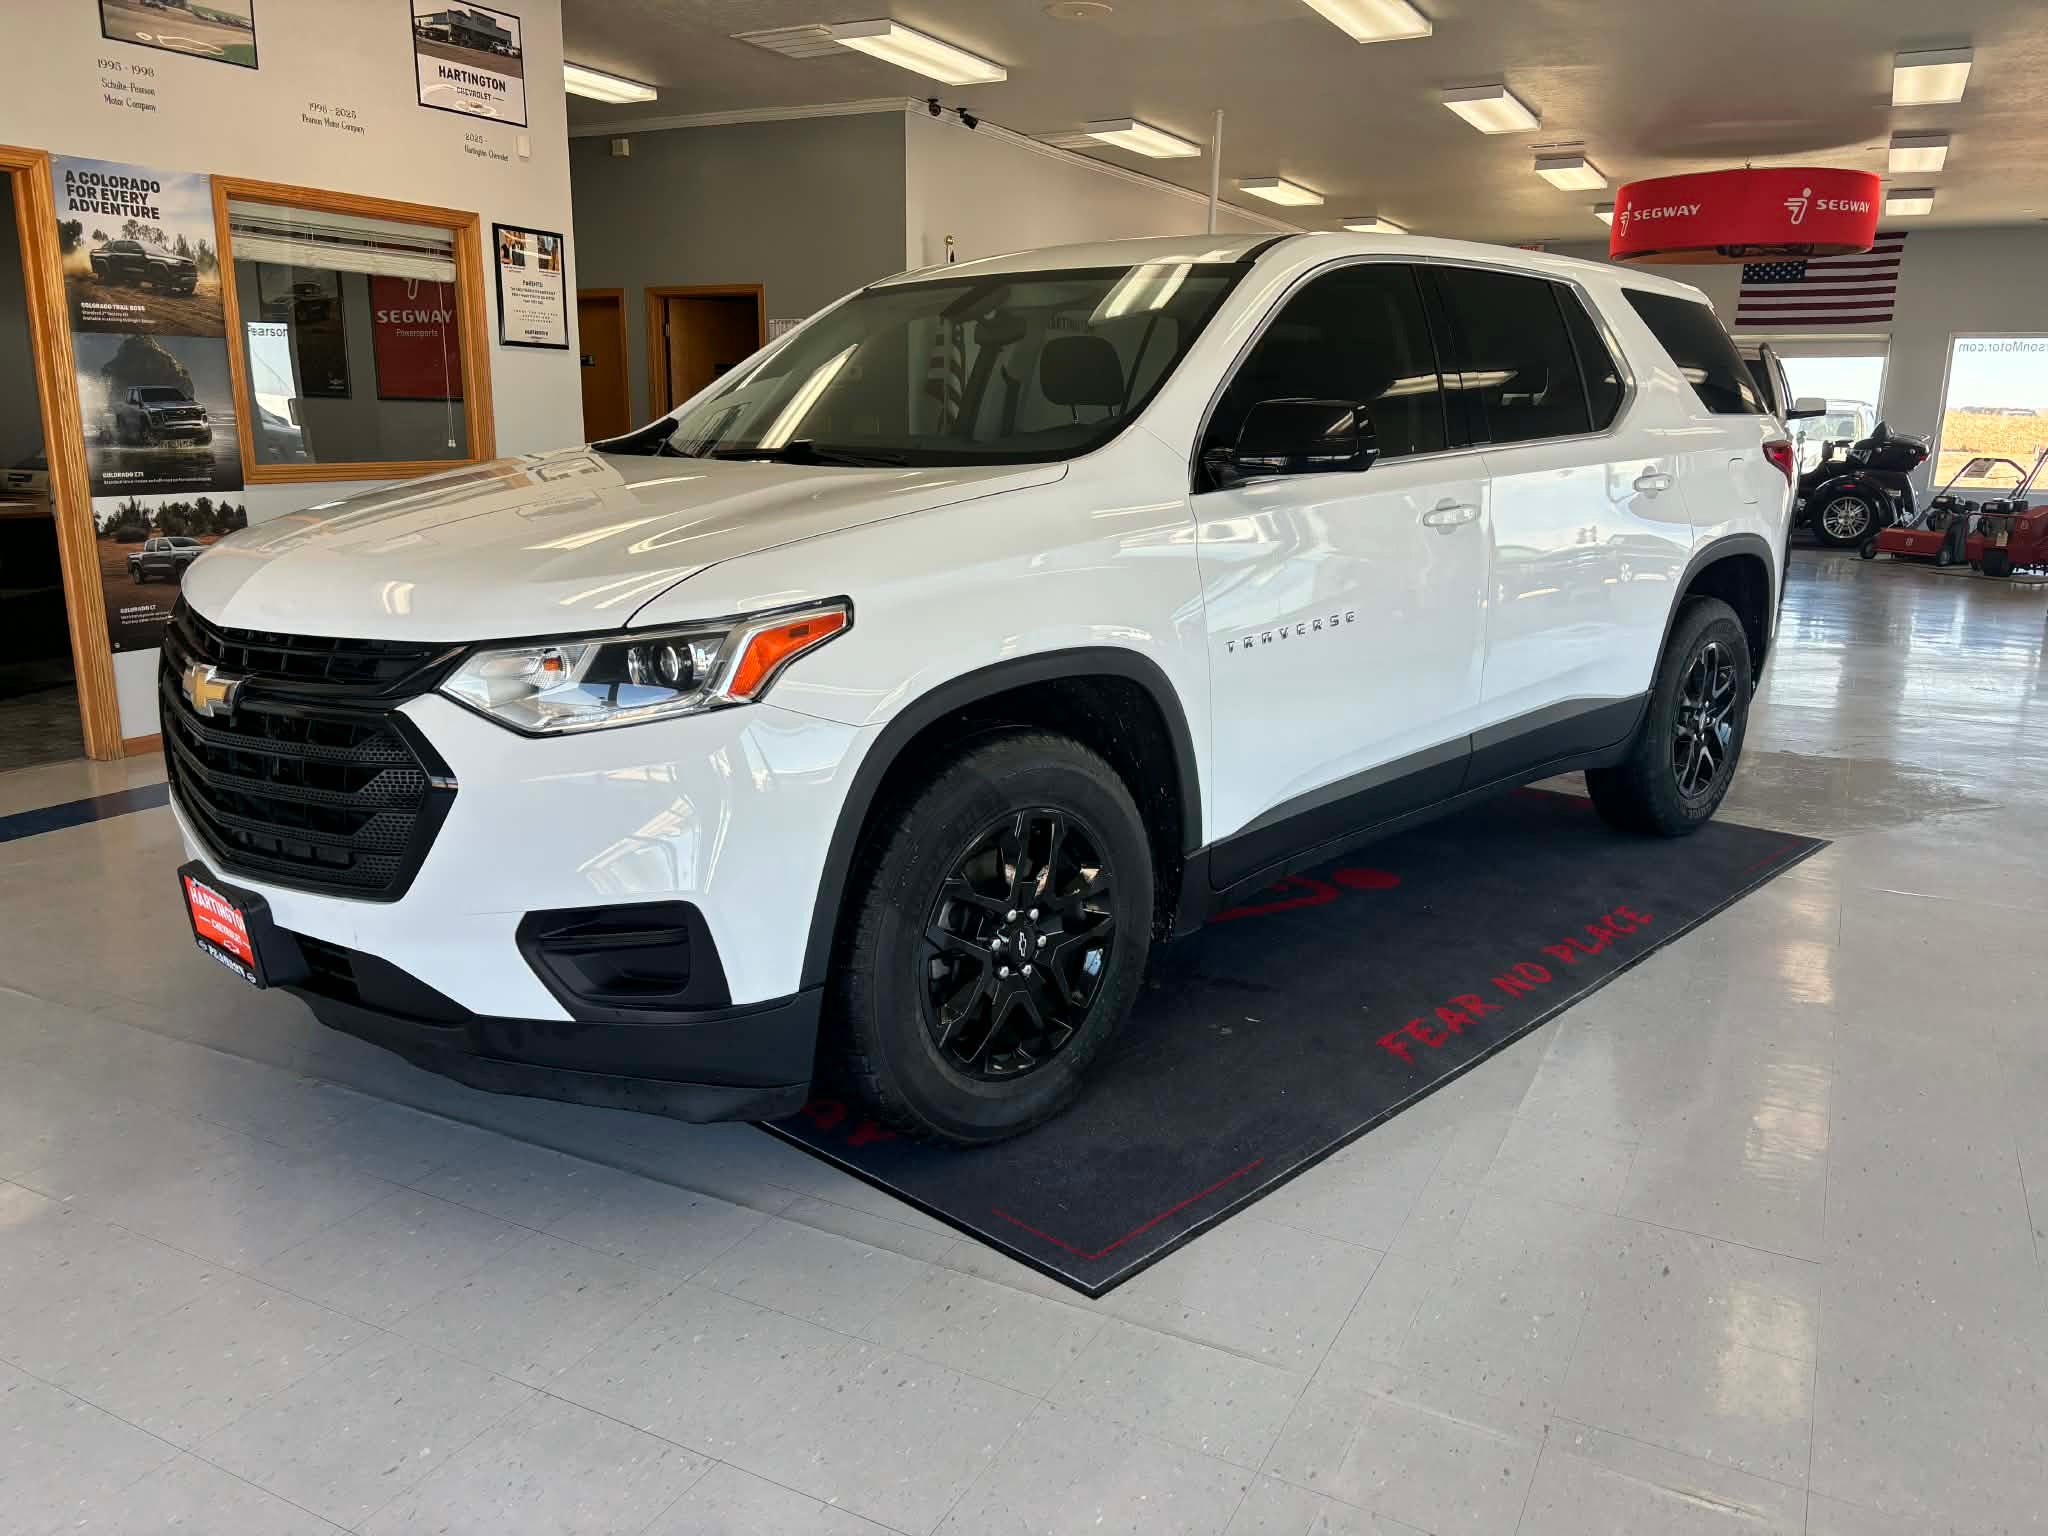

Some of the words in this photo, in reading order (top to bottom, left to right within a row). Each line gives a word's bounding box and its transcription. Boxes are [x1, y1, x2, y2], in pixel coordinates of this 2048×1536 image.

[438, 65, 506, 93] HARTINGTON
[456, 86, 492, 101] CHEVROLET
[126, 98, 156, 113] Company
[65, 170, 76, 184] A
[79, 171, 161, 194] COLORADO
[66, 183, 98, 200] FOR
[100, 187, 149, 206] EVERY
[68, 199, 161, 220] ADVENTURE
[1633, 203, 1702, 222] SEGWAY
[1815, 199, 1871, 214] SEGWAY
[376, 309, 453, 324] SEGWAY
[248, 327, 288, 337] earson
[395, 328, 439, 338] Powersports
[1226, 611, 1355, 653] TRAVERSE
[1376, 993, 1504, 1065] FEAR
[1491, 962, 1552, 1000] NO
[1541, 904, 1653, 965] PLACE
